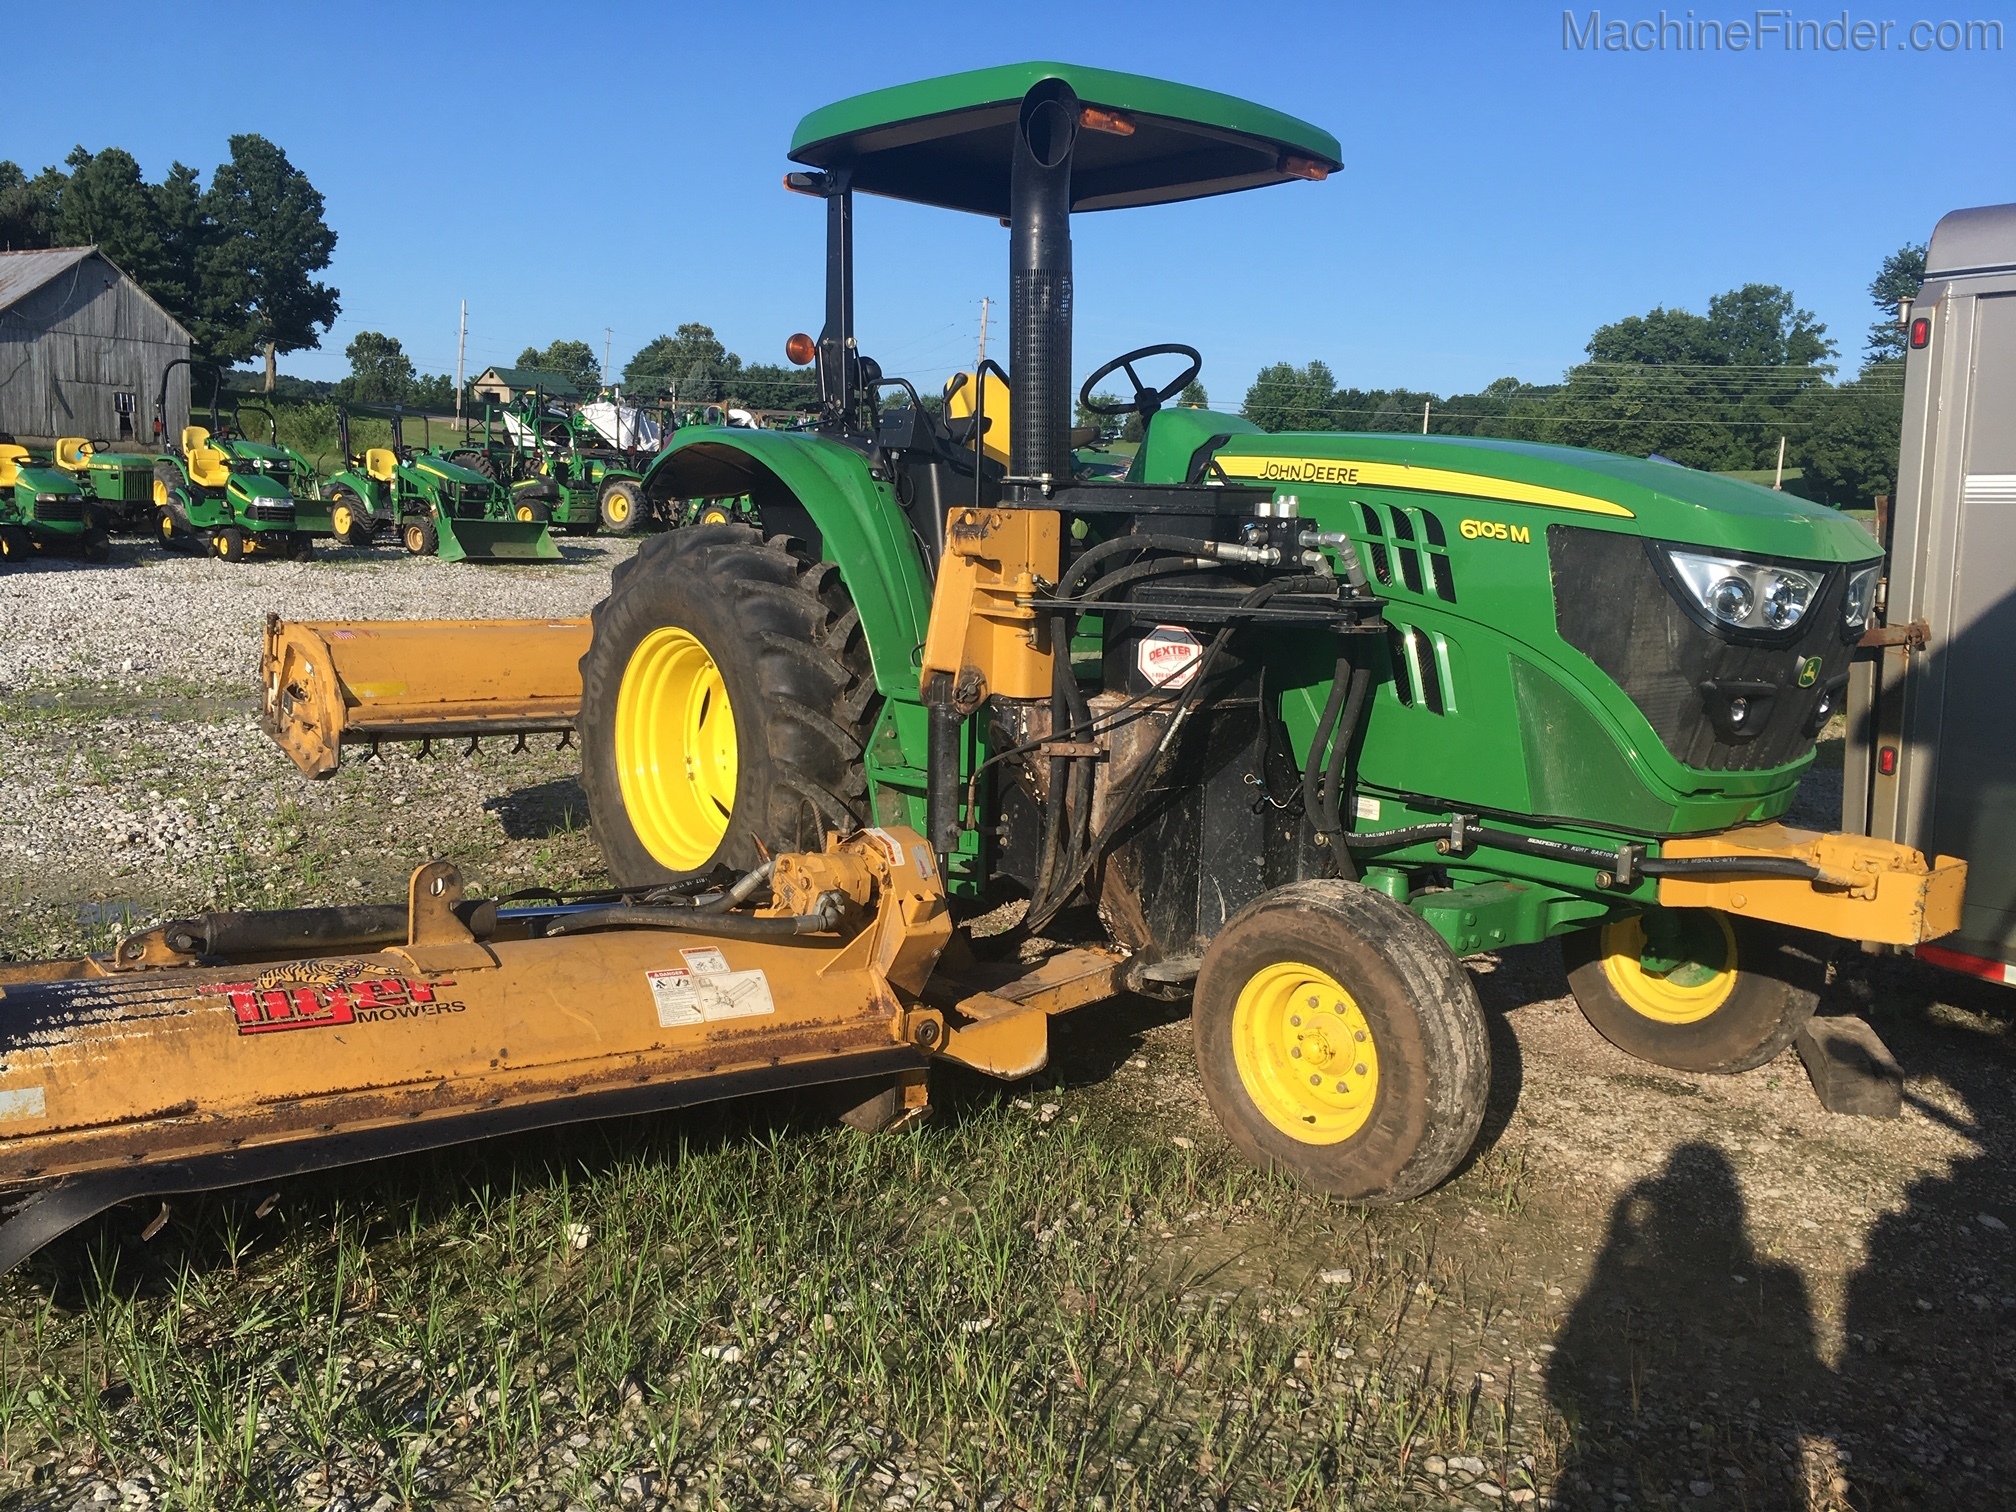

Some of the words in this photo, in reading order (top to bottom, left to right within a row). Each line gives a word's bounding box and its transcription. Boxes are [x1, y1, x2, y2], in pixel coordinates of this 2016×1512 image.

[1259, 461, 1302, 479] JOHN
[1303, 462, 1359, 482] DEERE
[1459, 519, 1508, 540] 6105
[1509, 524, 1531, 544] M
[1149, 645, 1191, 661] DEXTER
[1527, 837, 1562, 849] SEMPERIT
[357, 1000, 467, 1024] MOWERS
